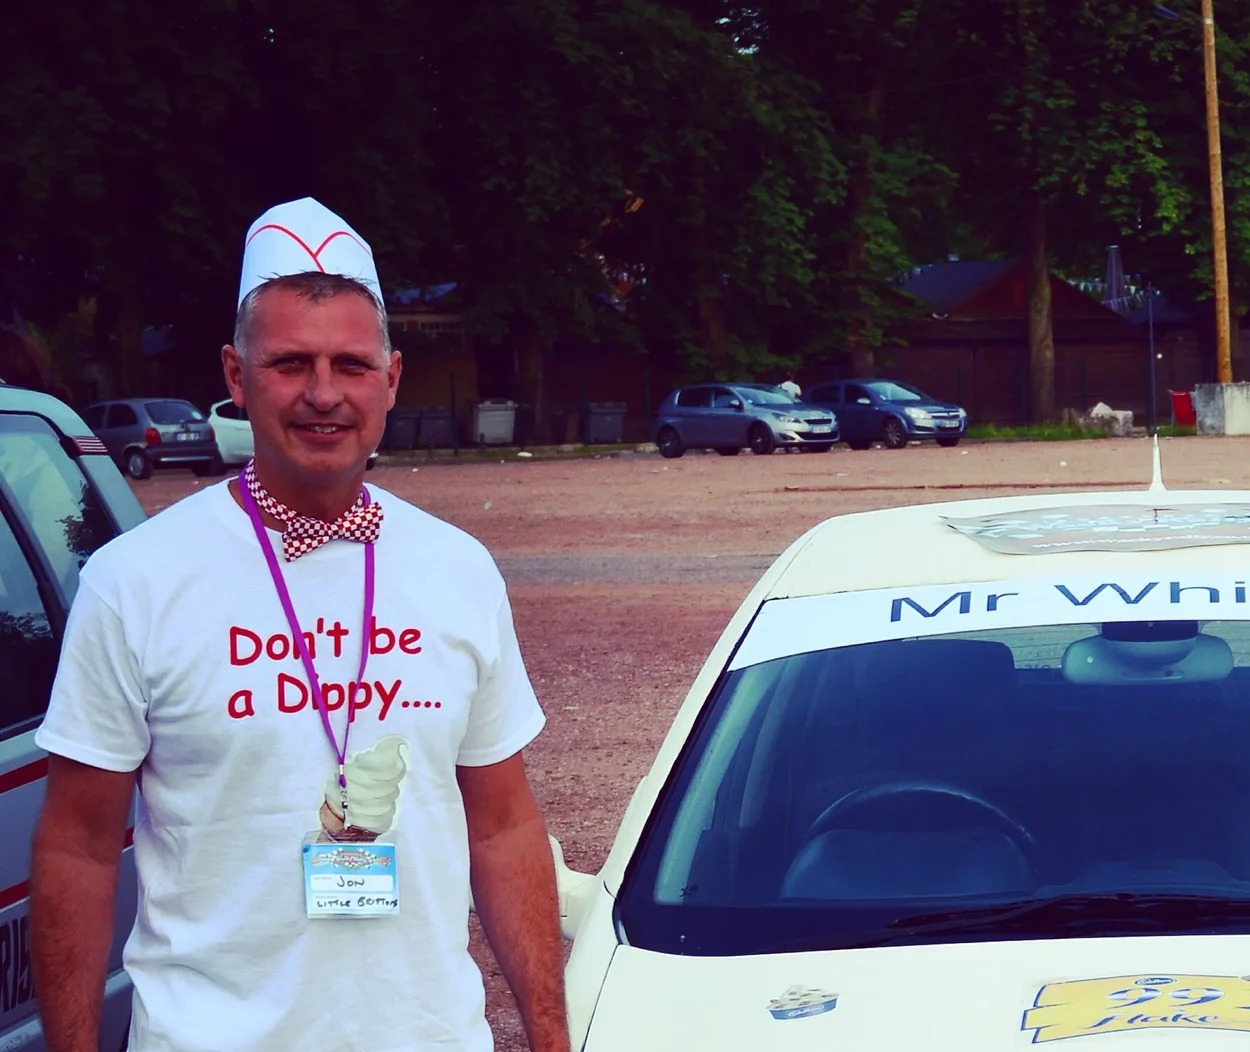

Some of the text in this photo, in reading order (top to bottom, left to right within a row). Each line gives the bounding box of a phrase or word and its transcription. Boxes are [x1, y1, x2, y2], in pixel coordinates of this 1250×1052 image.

[889, 590, 1020, 623] Mr
[229, 615, 422, 666] Don't be
[228, 689, 255, 719] a
[317, 899, 351, 908] LITTLE
